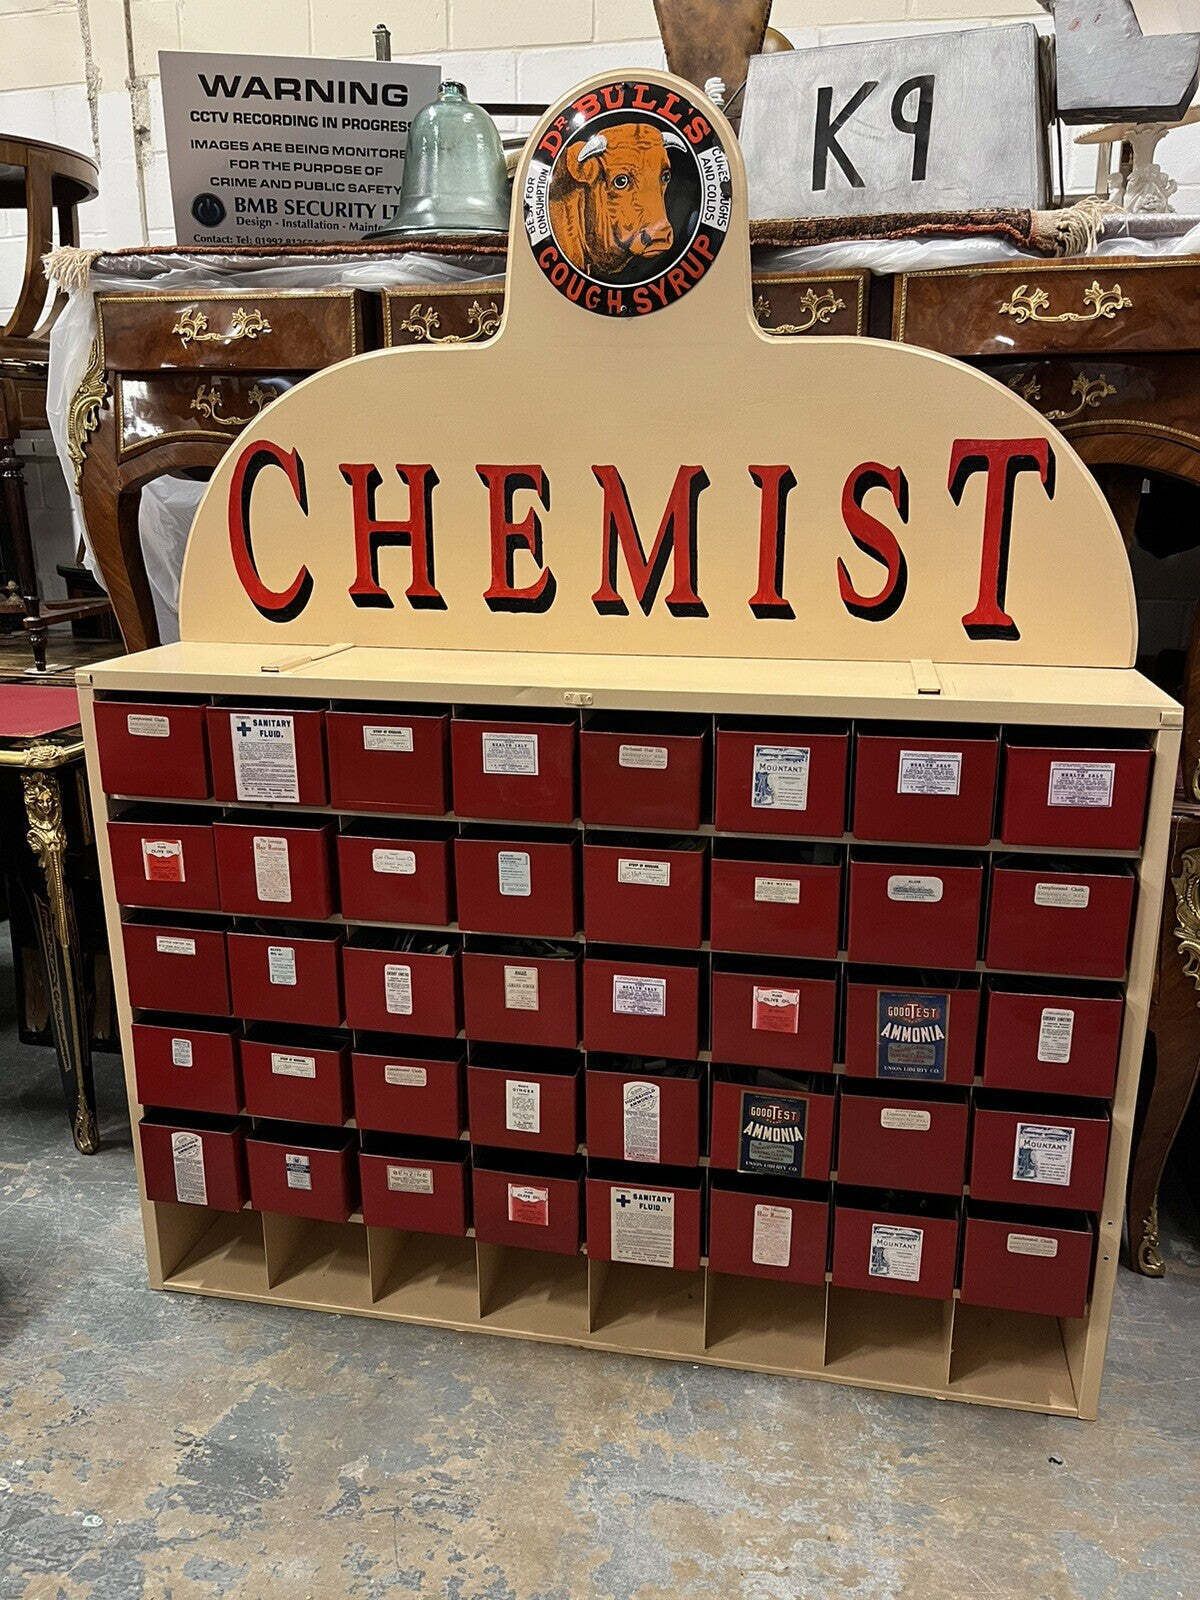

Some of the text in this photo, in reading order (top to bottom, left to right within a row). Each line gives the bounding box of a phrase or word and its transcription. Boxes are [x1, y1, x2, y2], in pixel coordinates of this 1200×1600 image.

[198, 73, 408, 107] WARNING
[190, 110, 229, 124] CCTV
[233, 112, 318, 128] RECORDING
[322, 115, 338, 129] IN
[572, 84, 712, 144] BULL'S
[190, 139, 406, 160] IMAGES ARE BEING MONITORE
[229, 159, 383, 177] FOR THE PURPOSE OF
[702, 157, 715, 180] AND
[210, 177, 402, 195] CRIME AND PUBLIC SAFETY
[526, 177, 535, 199] FOR
[234, 197, 400, 220] BMB SECURITY LT
[536, 168, 549, 235] CONSUMPTION
[236, 216, 272, 230] Design
[282, 218, 339, 231] Installation
[193, 234, 233, 244] Contact:
[236, 235, 252, 245] Tel:
[539, 234, 714, 314] COUGH SYRUP
[228, 438, 1056, 642] CHEMIST
[252, 719, 291, 728] SANITARY
[259, 730, 284, 738] FLUID.
[759, 763, 803, 772] MOUNTANT
[880, 1022, 945, 1042] AMMONIA
[743, 1121, 803, 1142] AMMONIA
[1023, 1140, 1067, 1150] MOUNTANT
[633, 1193, 672, 1203] SANITARY
[639, 1203, 663, 1212] FLUID.
[877, 1239, 917, 1249] MOUNTANT
